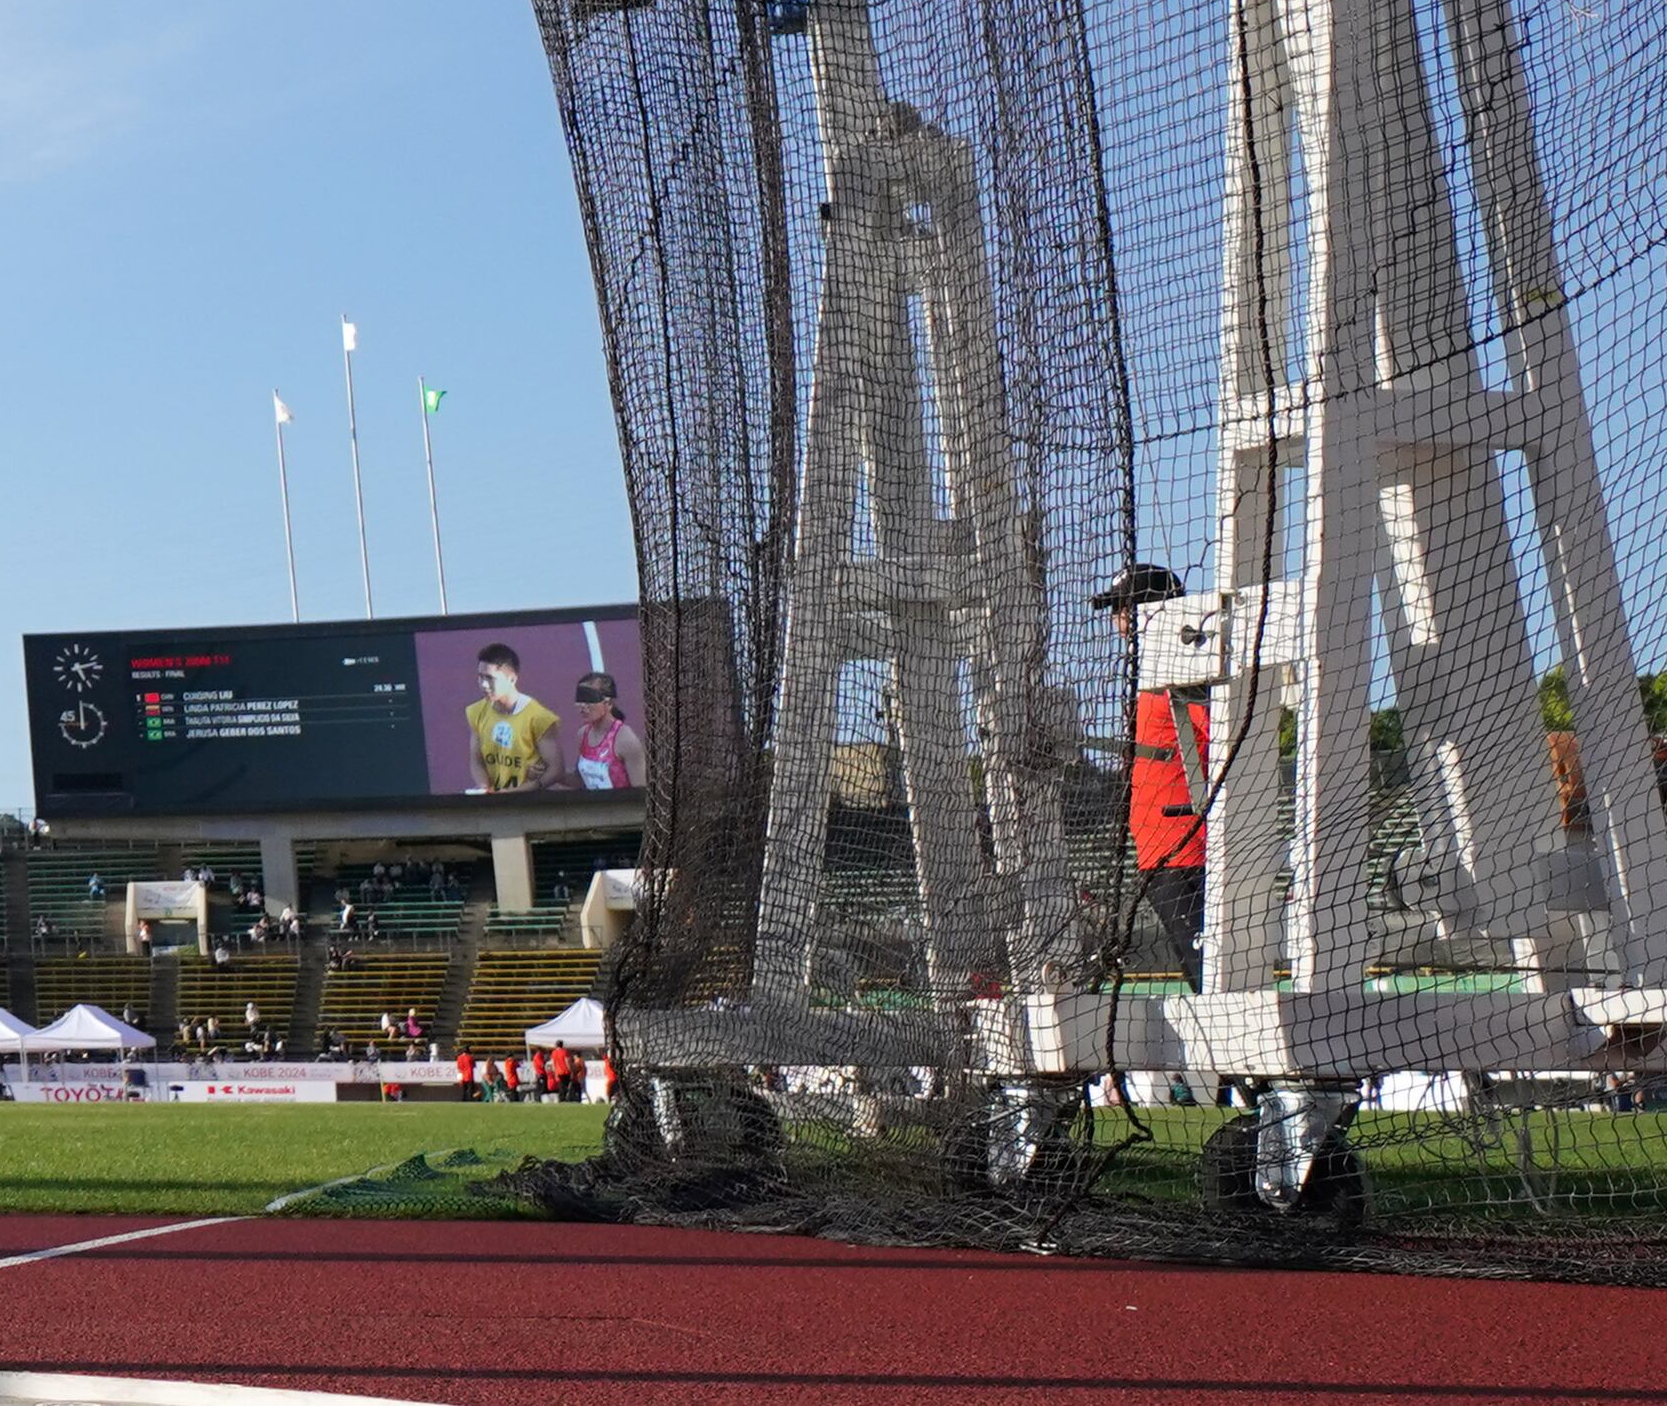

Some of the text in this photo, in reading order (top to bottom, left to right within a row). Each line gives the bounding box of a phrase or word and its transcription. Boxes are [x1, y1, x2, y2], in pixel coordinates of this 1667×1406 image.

[131, 670, 161, 679] RESULTS
[165, 669, 185, 678] FINAL
[184, 703, 208, 713] LINDA
[210, 702, 246, 712] PATRICIA
[247, 701, 272, 711] PEREZ
[273, 700, 299, 710] LOPEZ
[60, 710, 75, 722] 45
[187, 728, 218, 738] JERUSA
[219, 727, 246, 737] GEBER
[248, 726, 265, 736] DOS
[267, 725, 301, 735] SANTOS
[83, 1068, 115, 1078] KOBE
[243, 1068, 275, 1078] KOBE
[278, 1067, 306, 1078] 2024
[410, 1067, 443, 1078] KOBE
[237, 1085, 295, 1094] Kawasaki
